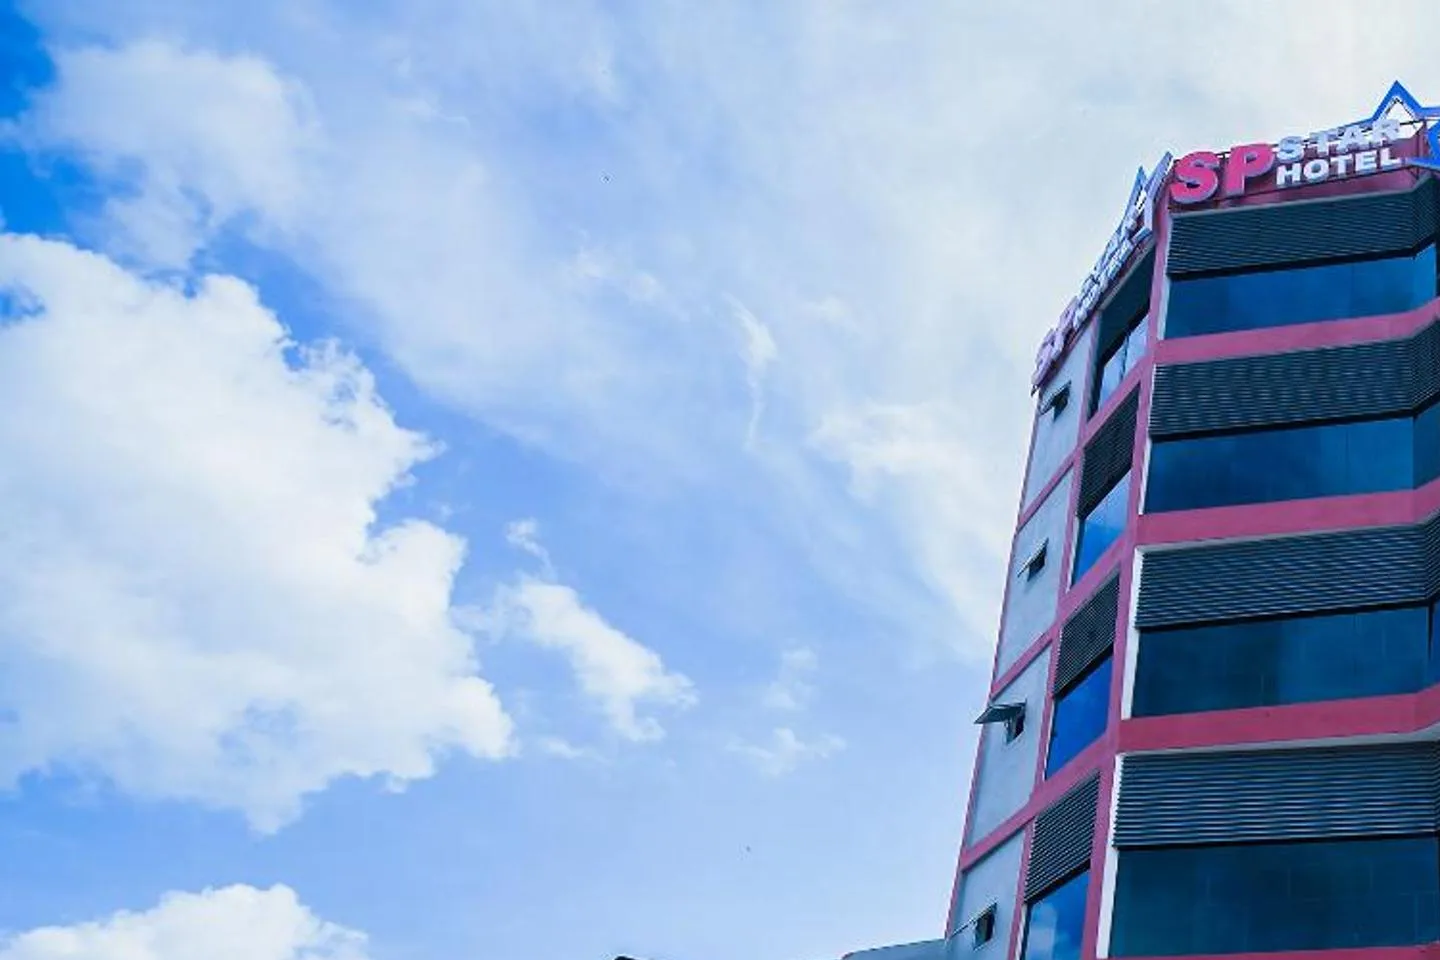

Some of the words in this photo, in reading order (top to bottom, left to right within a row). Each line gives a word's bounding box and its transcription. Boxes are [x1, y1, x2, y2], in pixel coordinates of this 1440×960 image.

[1170, 143, 1275, 203] SP
[1276, 118, 1400, 161] STAR
[1276, 148, 1400, 187] HOTEL
